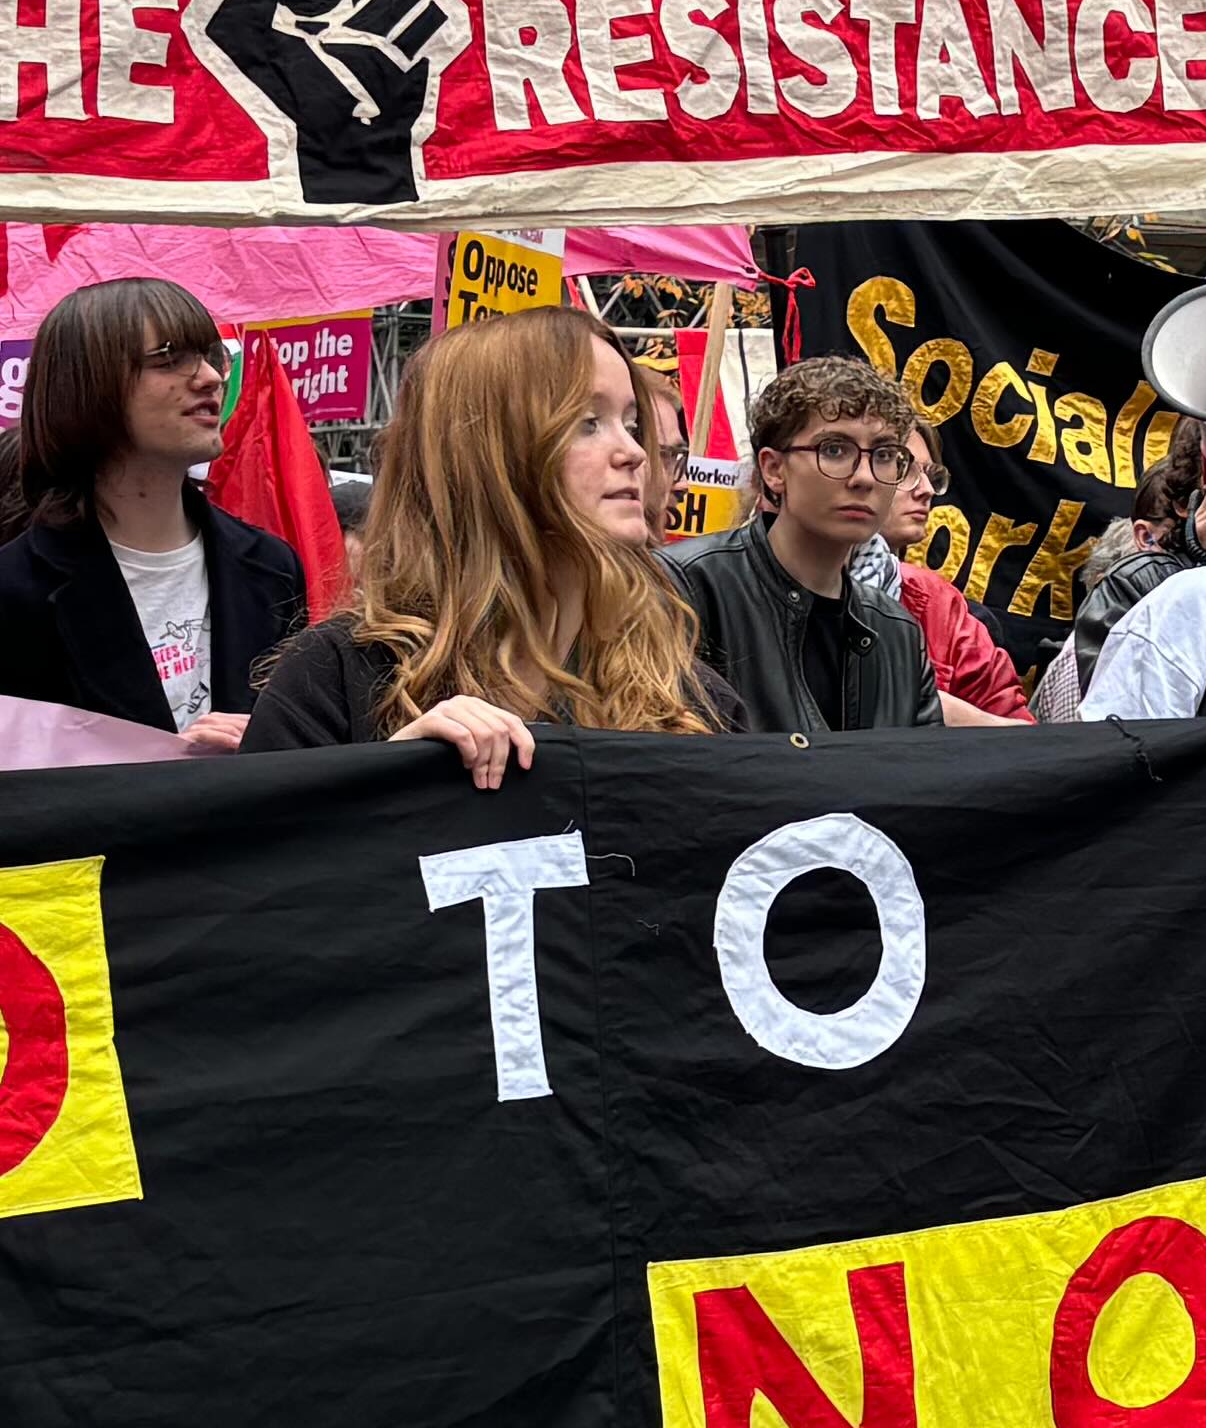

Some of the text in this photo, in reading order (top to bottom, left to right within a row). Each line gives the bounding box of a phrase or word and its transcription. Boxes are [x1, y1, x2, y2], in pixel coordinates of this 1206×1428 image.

[462, 239, 539, 298] Oppose
[315, 327, 354, 359] the
[292, 364, 349, 404] right
[418, 811, 927, 1103] TO
